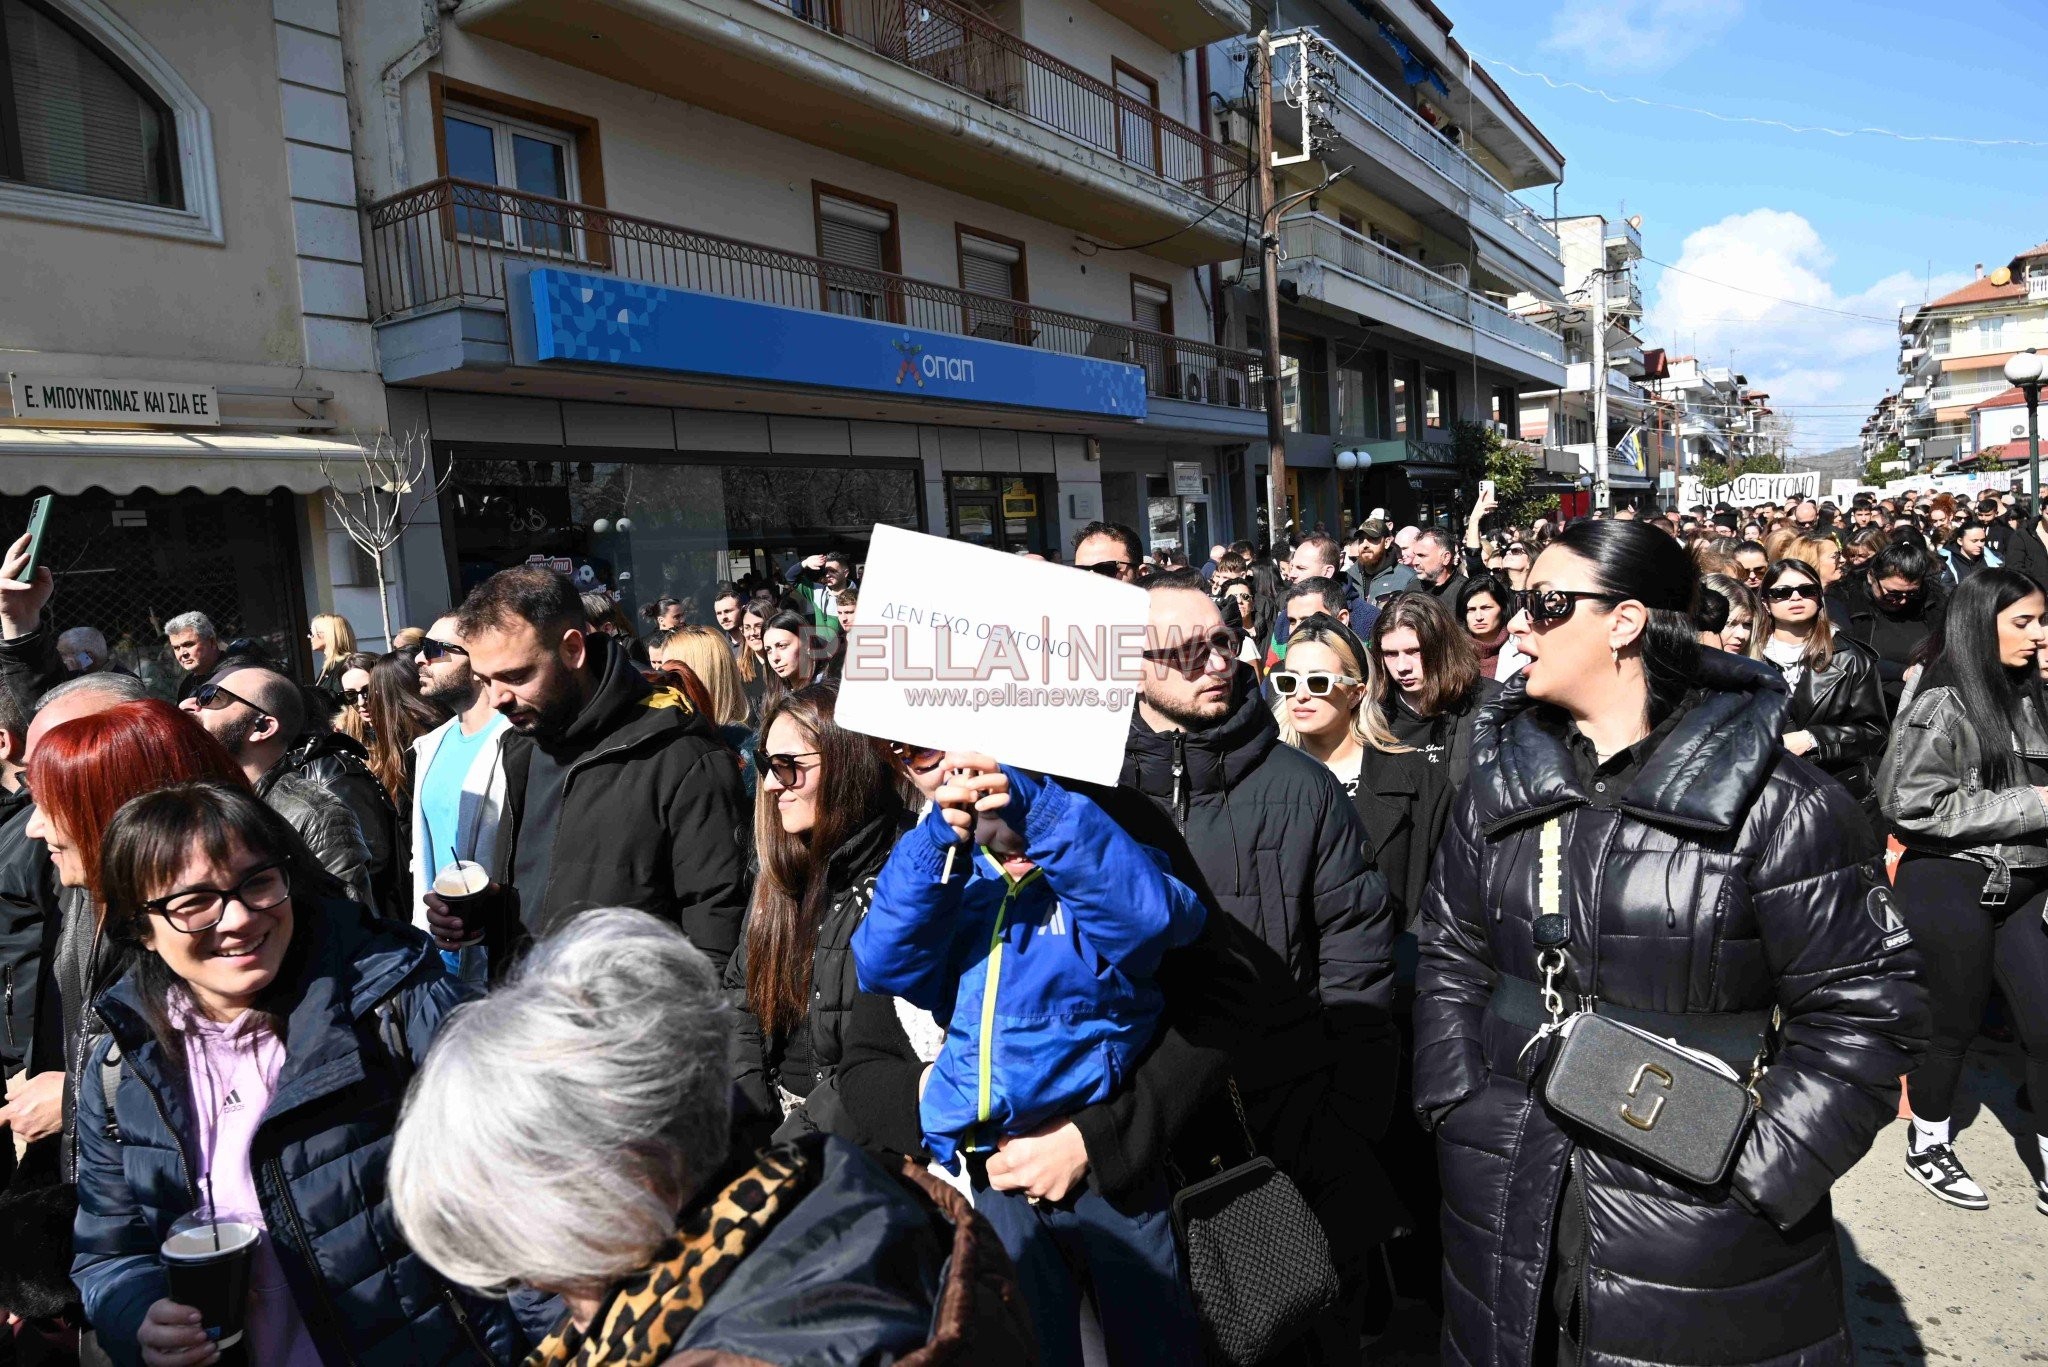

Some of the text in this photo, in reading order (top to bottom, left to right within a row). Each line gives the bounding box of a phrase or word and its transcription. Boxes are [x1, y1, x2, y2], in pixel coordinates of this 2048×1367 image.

[43, 386, 140, 412] ΜΠΟΥΝΤΩΝΑΣ
[144, 391, 165, 413] ΚΑΙ
[168, 392, 190, 414] ΣΙΑ
[192, 394, 208, 415] ΕΕ
[881, 602, 923, 625] ΔΕΝ
[930, 611, 970, 636] ΕΧΩ
